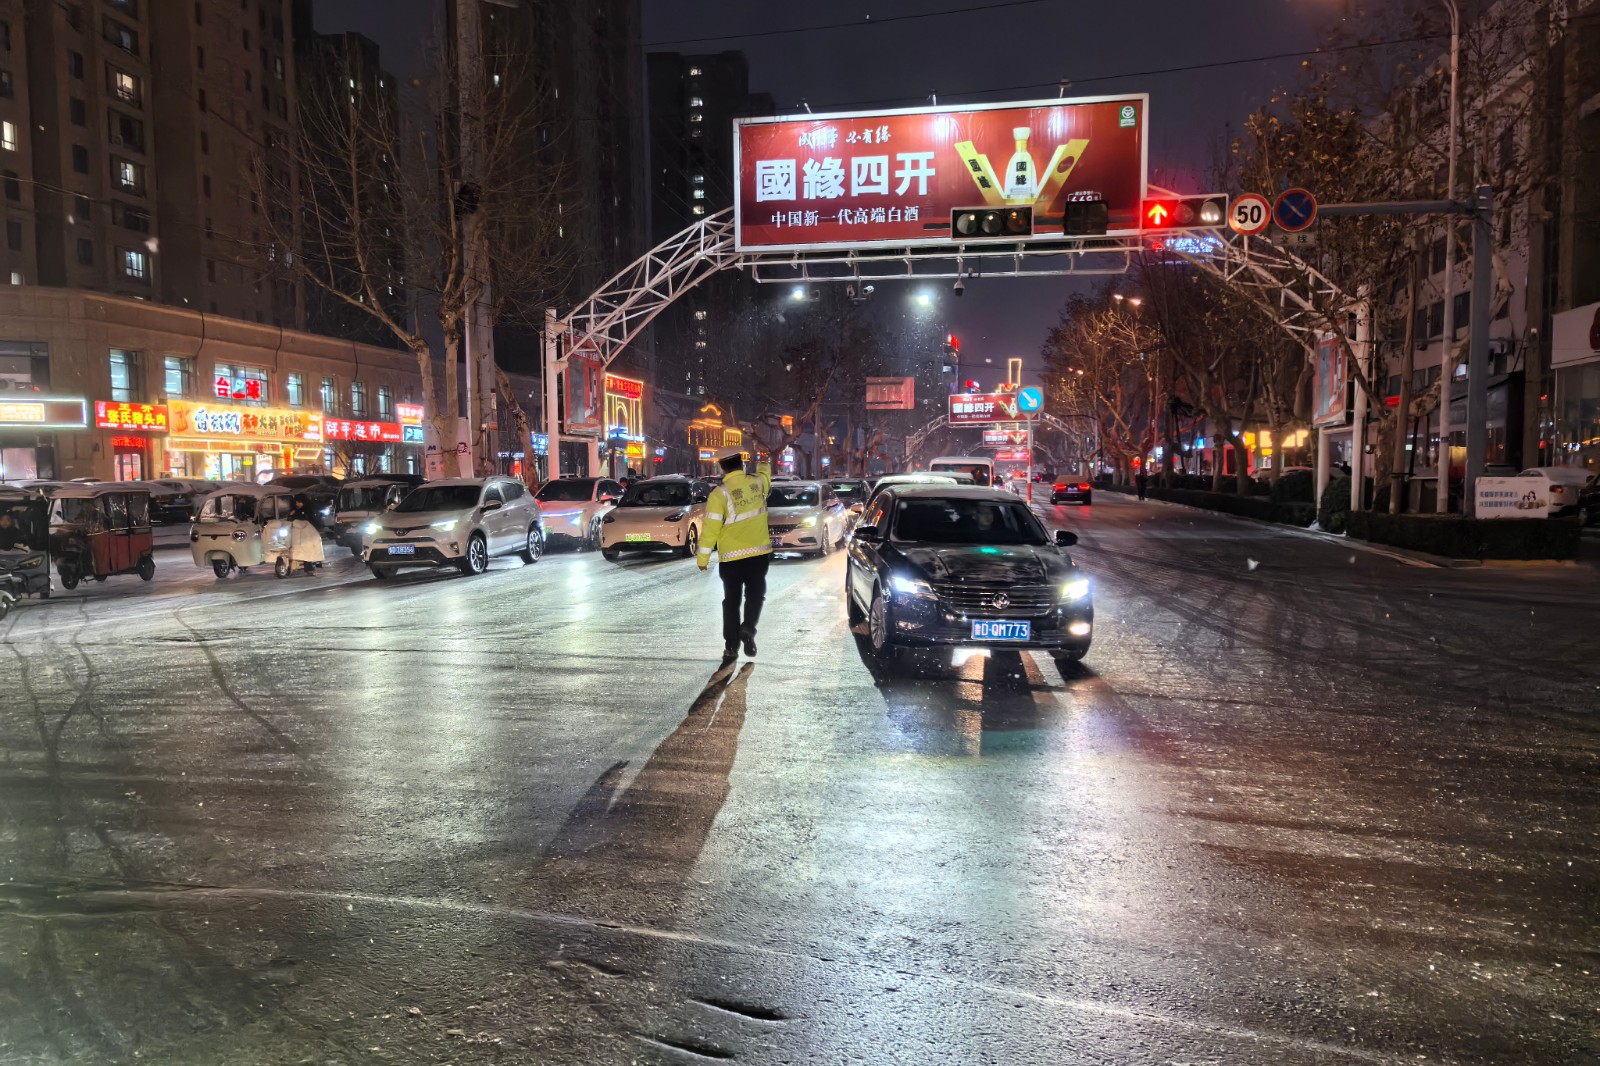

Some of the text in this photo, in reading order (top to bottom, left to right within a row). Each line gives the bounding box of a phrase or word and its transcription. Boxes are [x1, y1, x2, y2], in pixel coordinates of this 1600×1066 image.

[771, 205, 920, 229] 中国新一代高端白酒
[1237, 205, 1262, 224] 50
[107, 410, 166, 426] 张氏猪头肉
